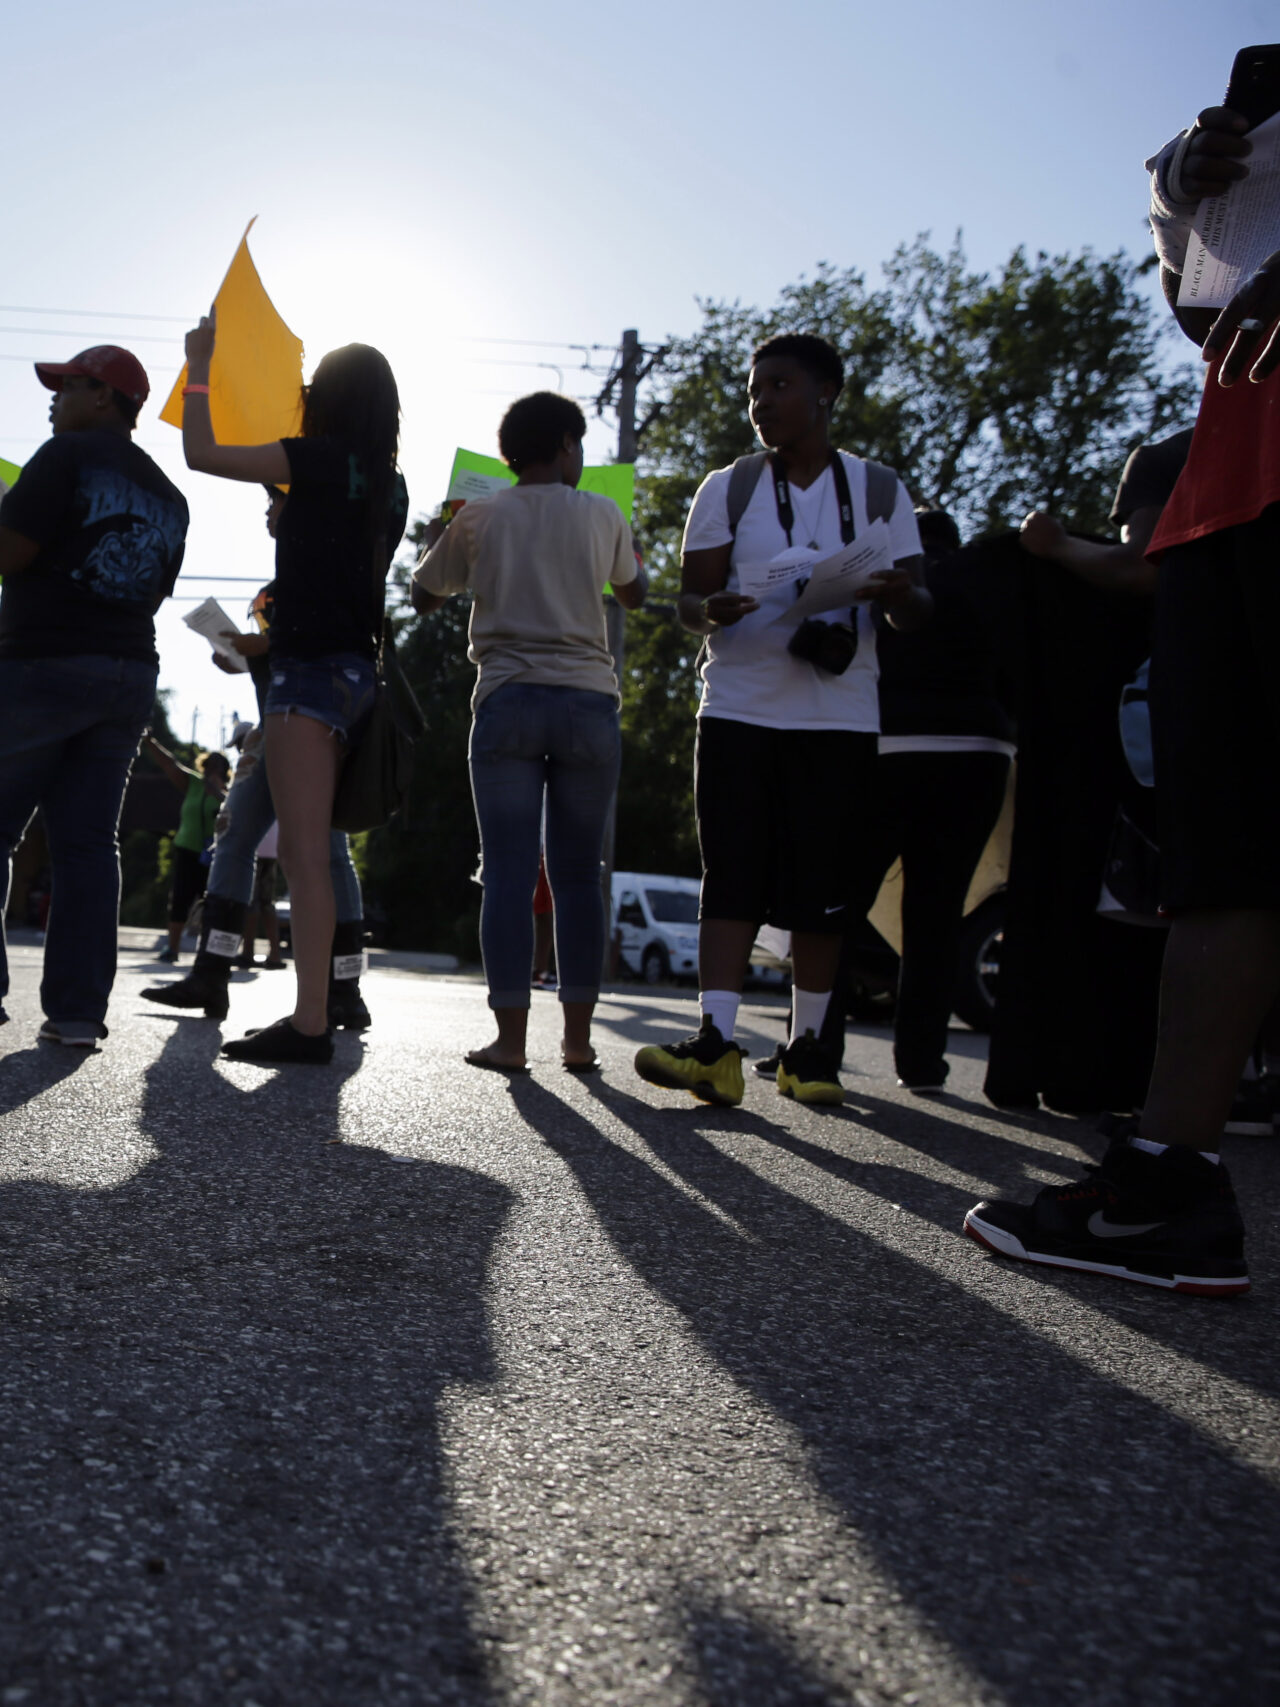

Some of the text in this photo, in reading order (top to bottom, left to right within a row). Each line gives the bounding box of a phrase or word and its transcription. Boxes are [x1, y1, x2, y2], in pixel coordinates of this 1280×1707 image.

[1215, 202, 1227, 226] MUST
[1190, 199, 1217, 297] BLACK MAN MURDERED
[1211, 226, 1221, 247] THIS
